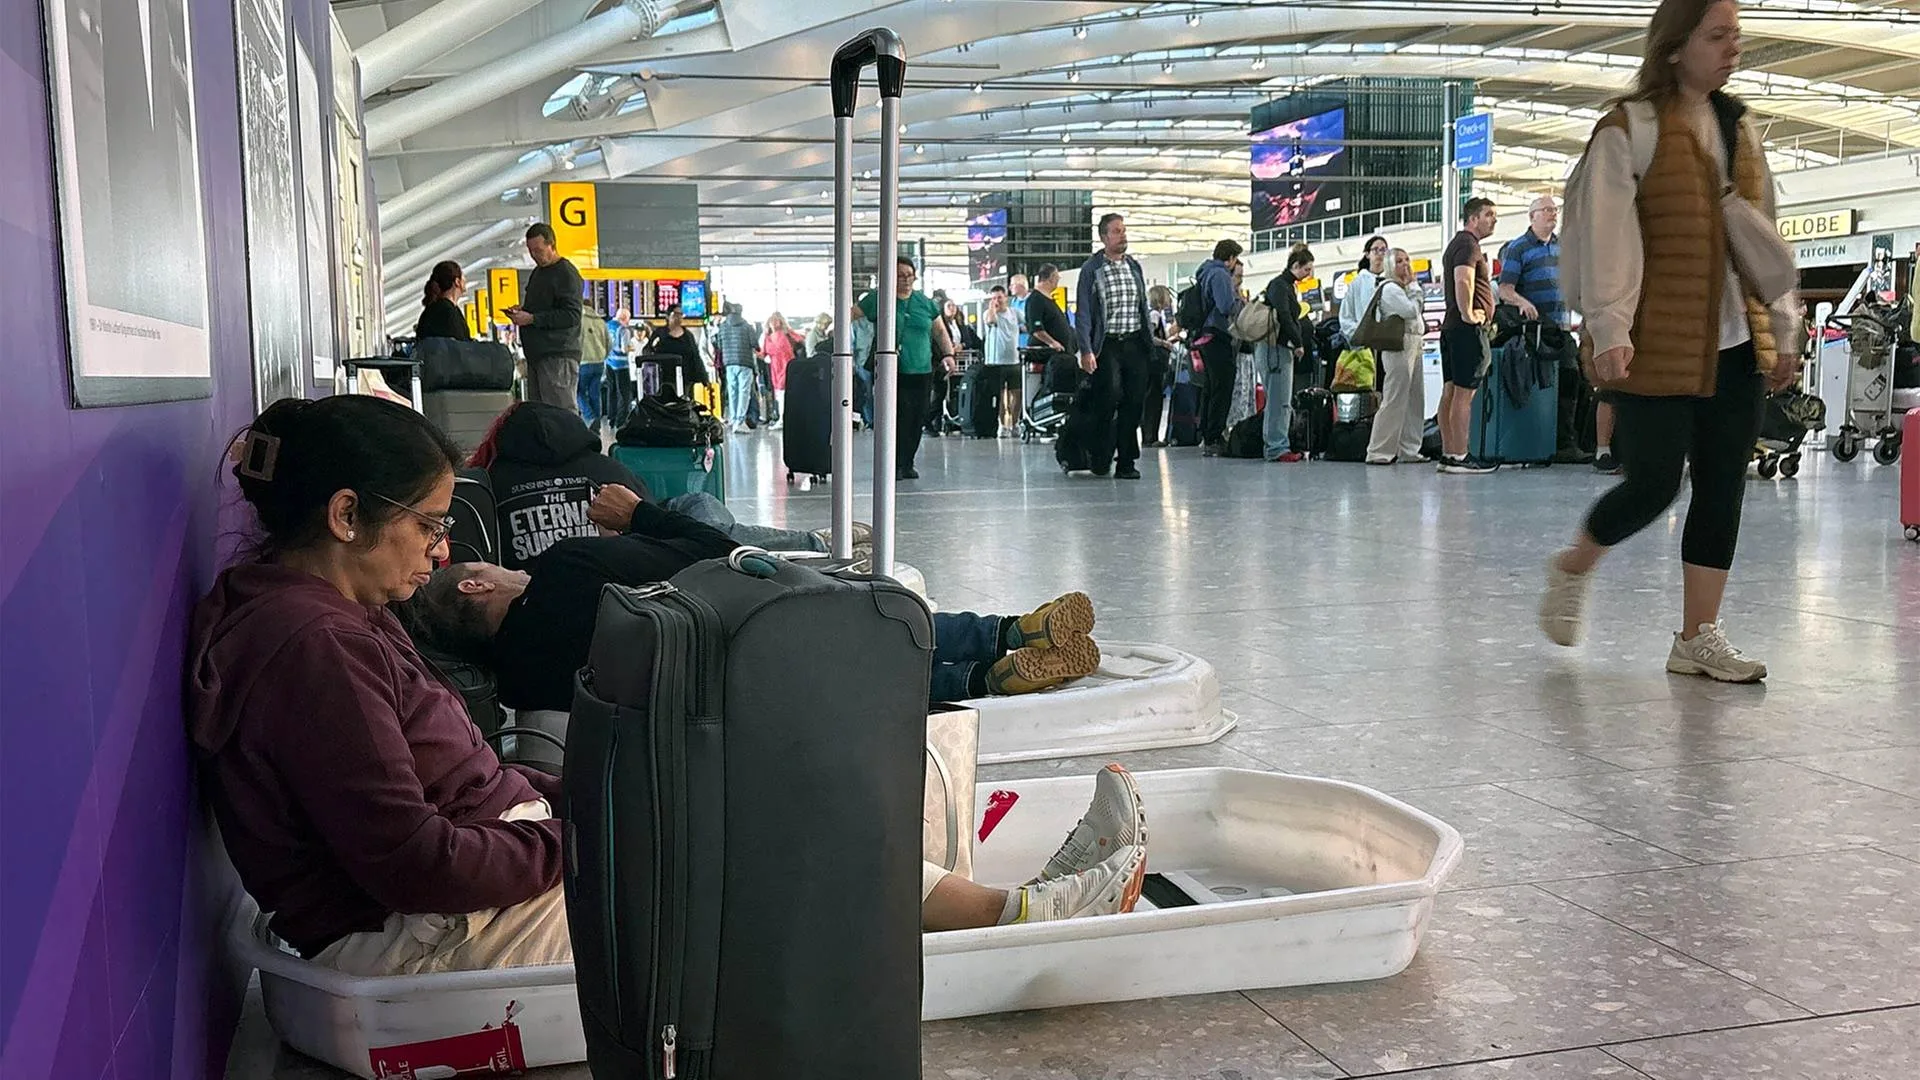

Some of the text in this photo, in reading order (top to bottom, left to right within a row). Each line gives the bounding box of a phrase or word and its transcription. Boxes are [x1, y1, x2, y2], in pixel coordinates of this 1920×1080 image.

[1459, 121, 1486, 136] Check-in
[559, 196, 586, 227] G
[1780, 215, 1840, 237] GLOBE
[1800, 245, 1846, 258] KITCHEN
[499, 276, 509, 294] F
[543, 492, 566, 504] THE
[510, 500, 595, 536] ETERNA
[511, 524, 600, 560] SUNSHIN
